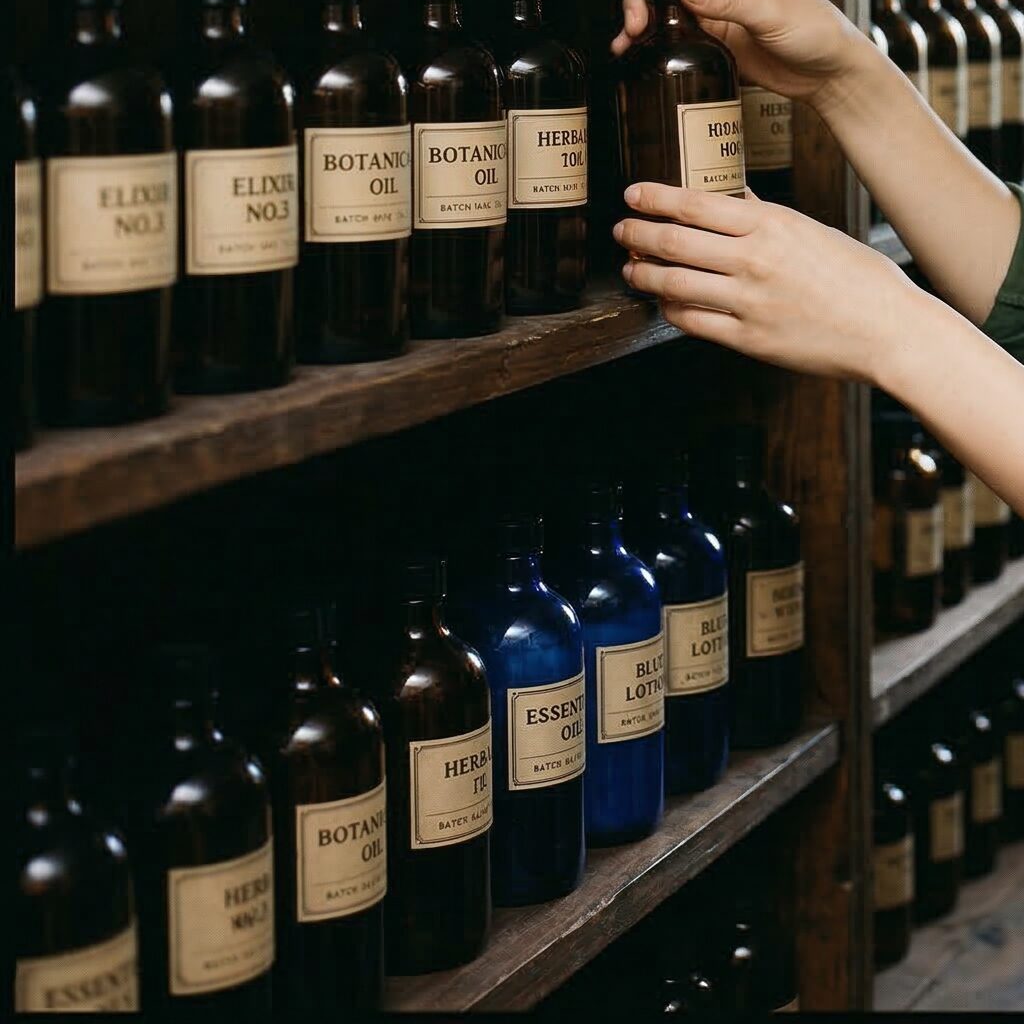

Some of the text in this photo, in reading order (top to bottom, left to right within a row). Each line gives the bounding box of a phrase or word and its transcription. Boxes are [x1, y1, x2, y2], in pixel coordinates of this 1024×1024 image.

[369, 176, 399, 196] OIL
[474, 167, 499, 186] OIL
[318, 810, 386, 848] BOTANI
[361, 836, 385, 864] OIL
